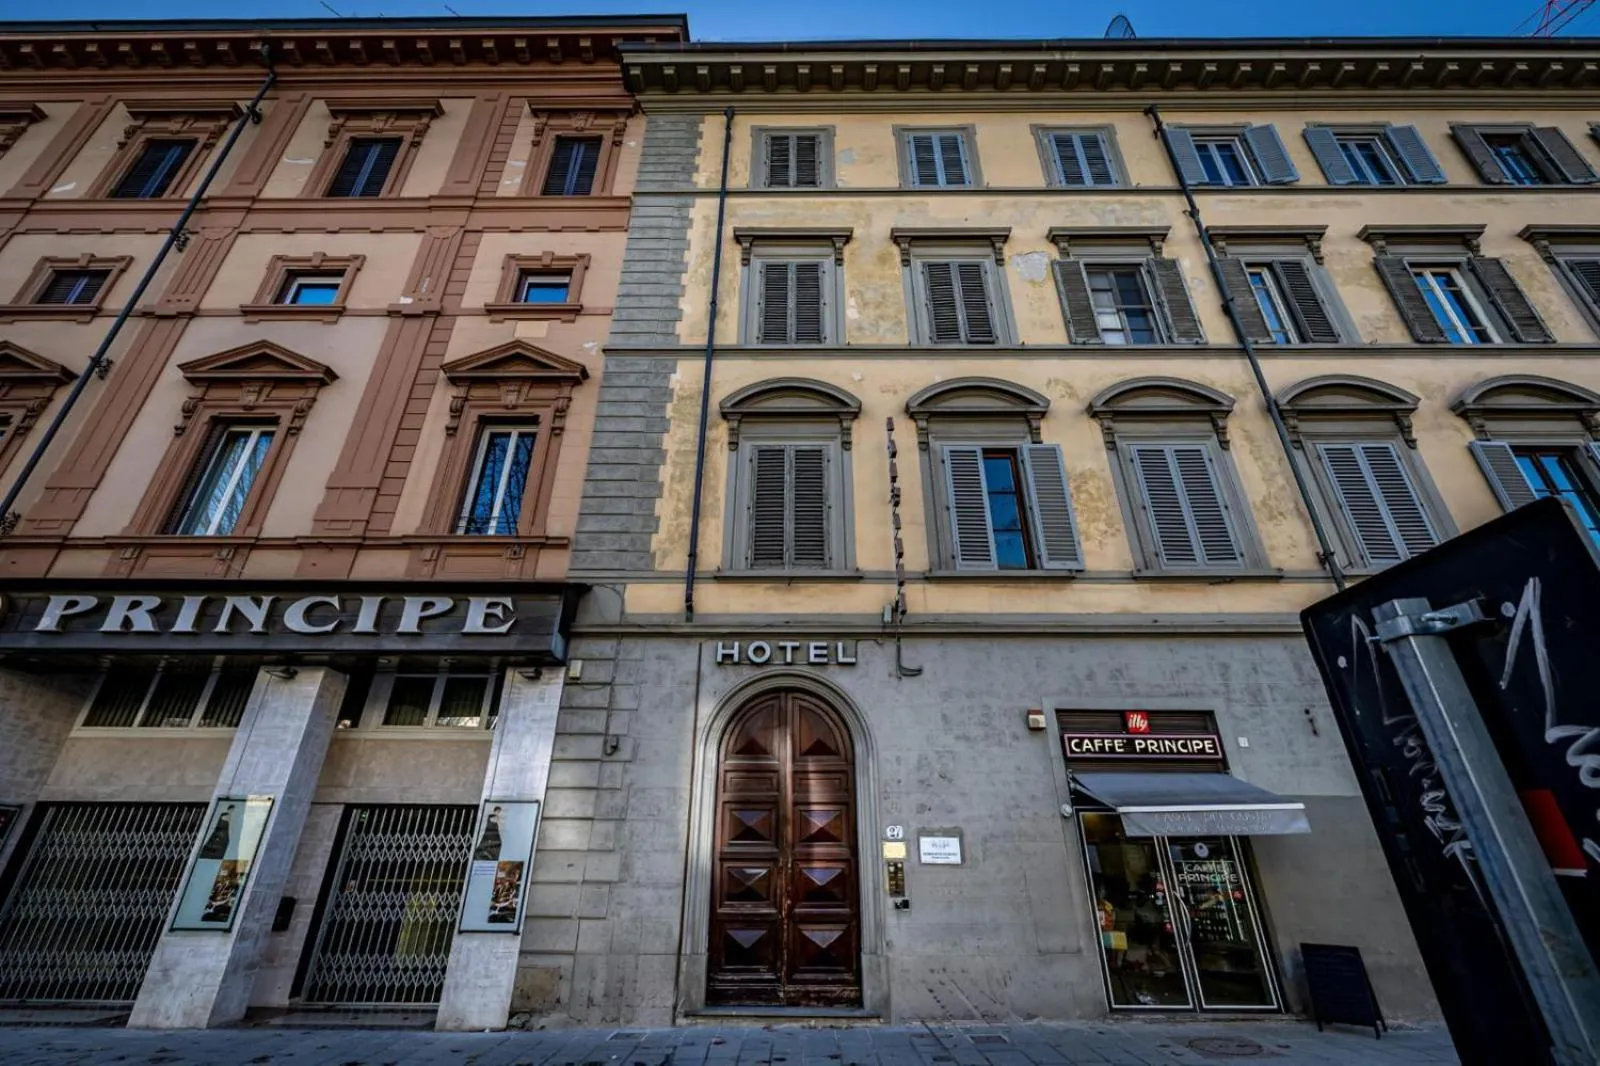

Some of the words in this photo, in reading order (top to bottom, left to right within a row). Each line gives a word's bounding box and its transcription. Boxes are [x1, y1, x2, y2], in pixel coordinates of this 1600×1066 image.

[33, 594, 518, 633] PRINCIPE
[716, 640, 856, 664] HOTEL
[1128, 713, 1149, 732] illy
[1135, 739, 1215, 754] PRINCIPE
